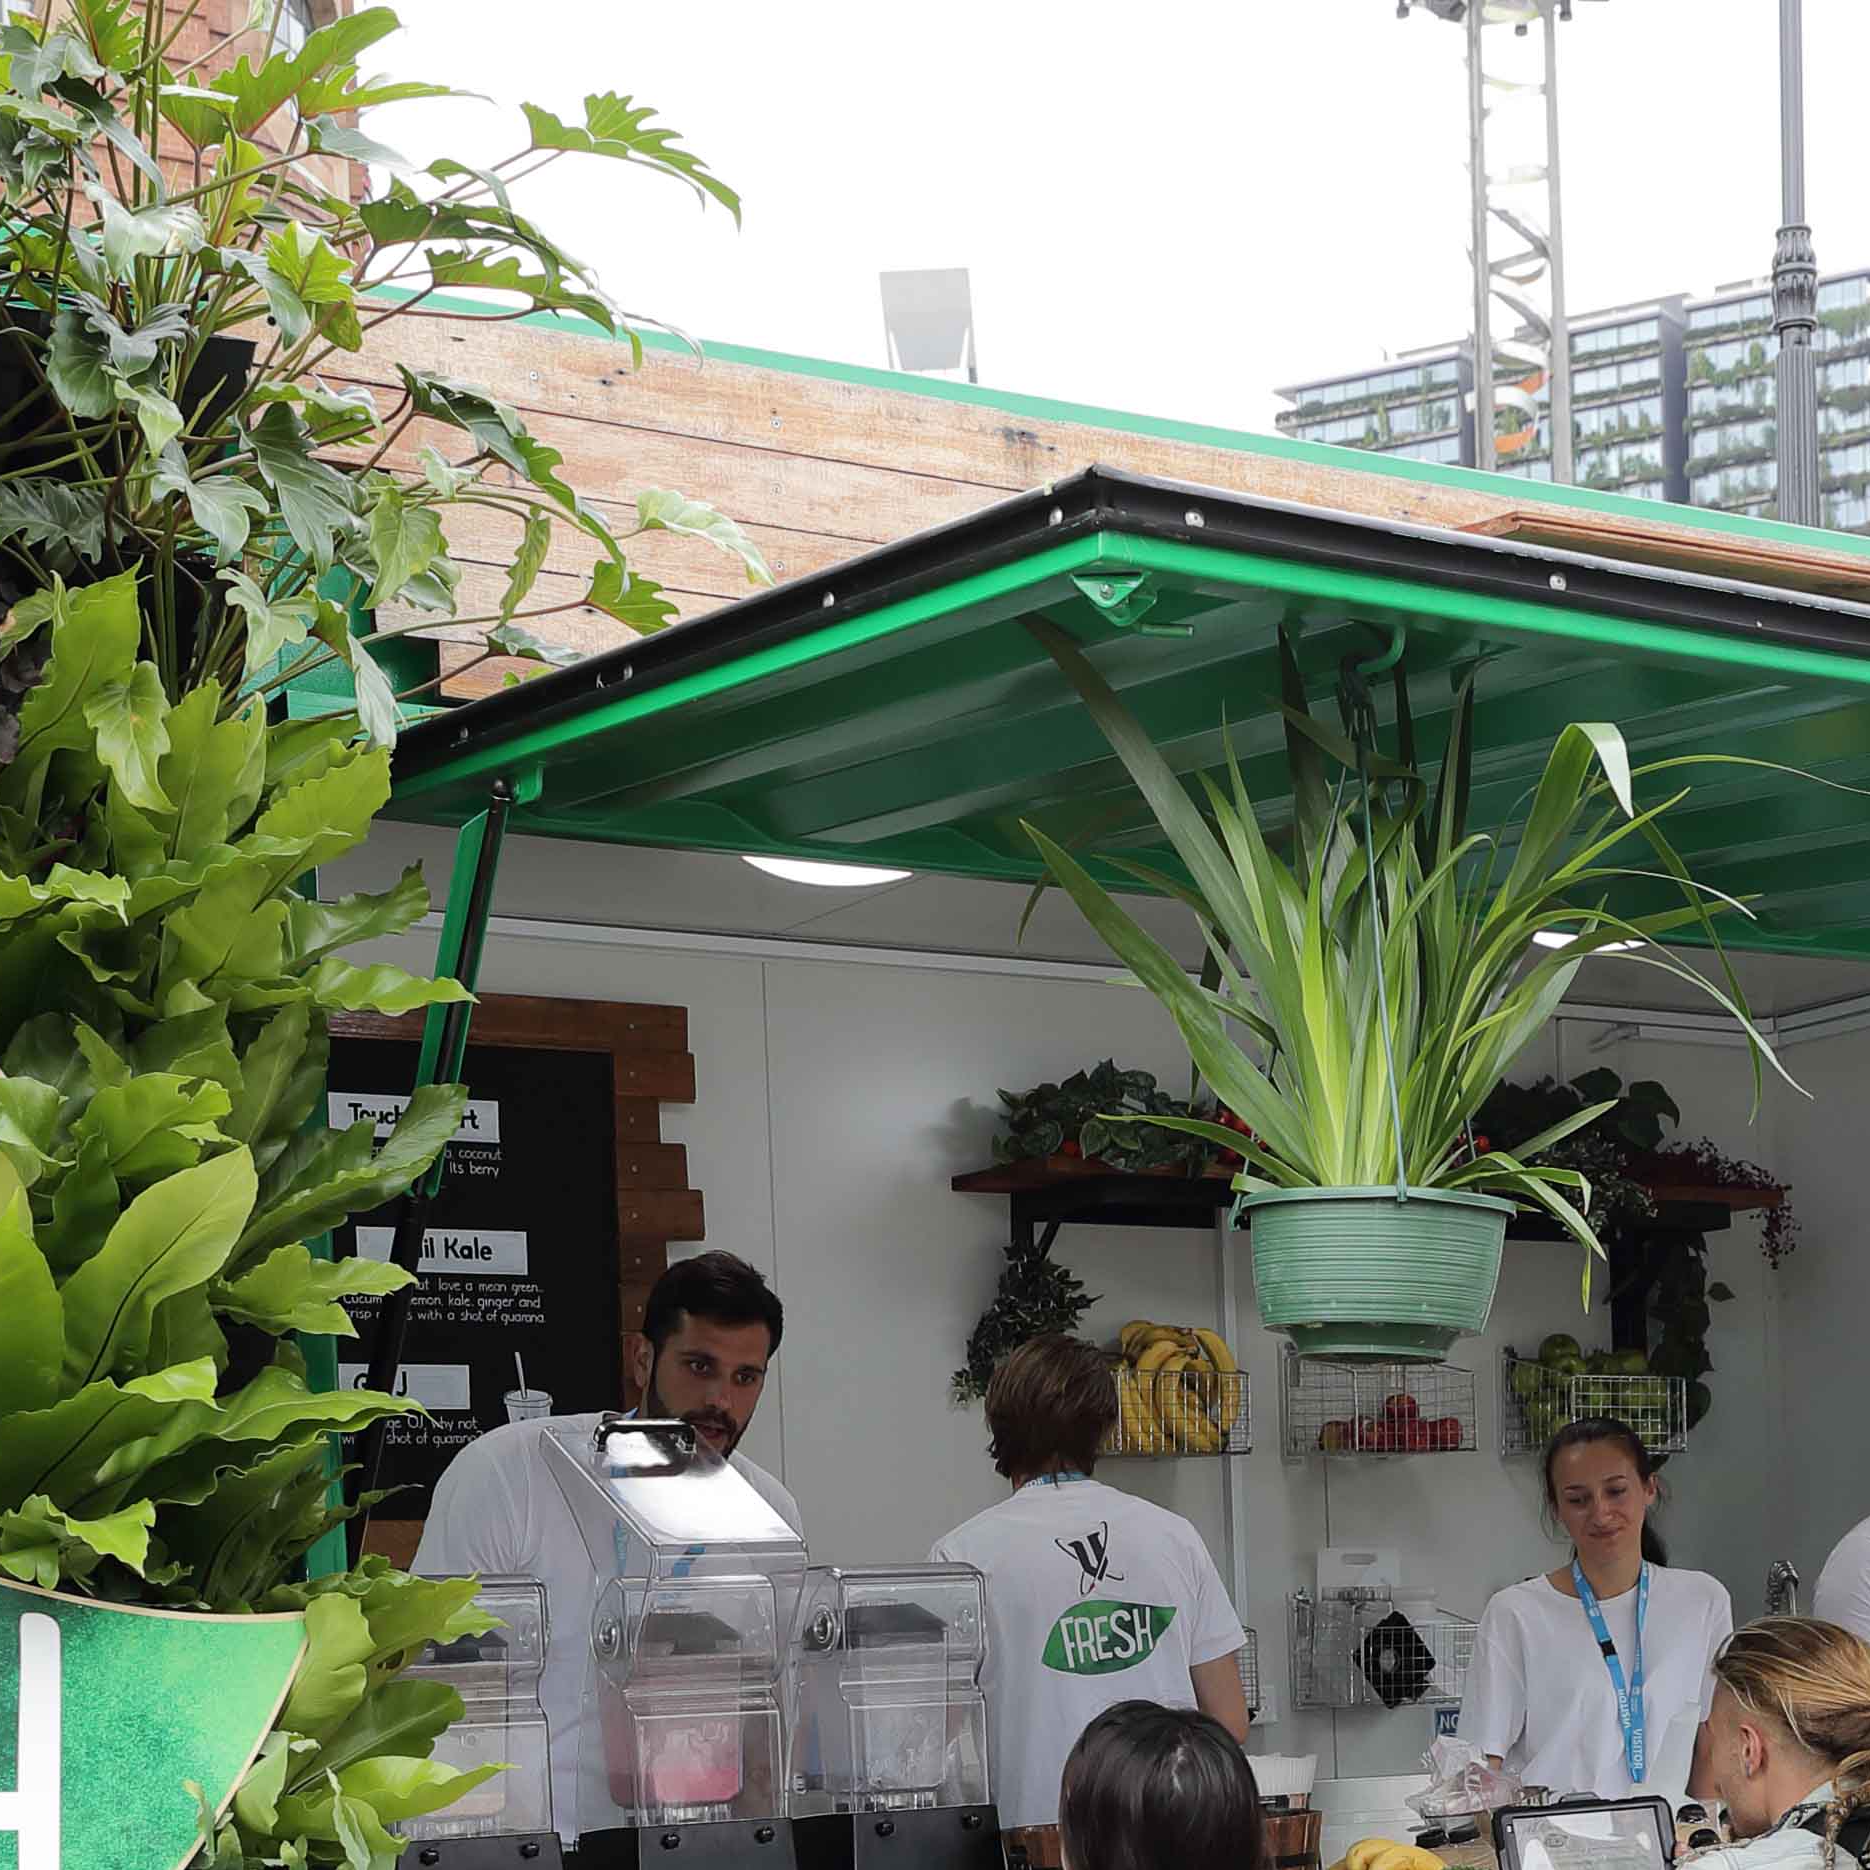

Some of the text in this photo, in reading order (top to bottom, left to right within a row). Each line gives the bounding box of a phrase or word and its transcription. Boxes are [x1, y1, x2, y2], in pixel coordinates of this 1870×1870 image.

[458, 1149, 503, 1161] coconut
[469, 1161, 499, 1178] berry
[444, 1237, 493, 1261] Kale
[438, 1278, 461, 1291] love
[465, 1282, 474, 1292] a
[478, 1282, 507, 1292] mean
[342, 1294, 383, 1304] Cucum
[477, 1297, 514, 1309] ginger
[518, 1297, 541, 1308] and
[417, 1308, 443, 1320] with
[447, 1312, 455, 1321] a
[460, 1309, 483, 1322] shot
[486, 1310, 498, 1321] of
[454, 1416, 479, 1430] not
[385, 1430, 411, 1445] shot
[416, 1431, 429, 1445] of
[1060, 1606, 1153, 1669] FRESH
[1633, 1728, 1643, 1769] VISITOR
